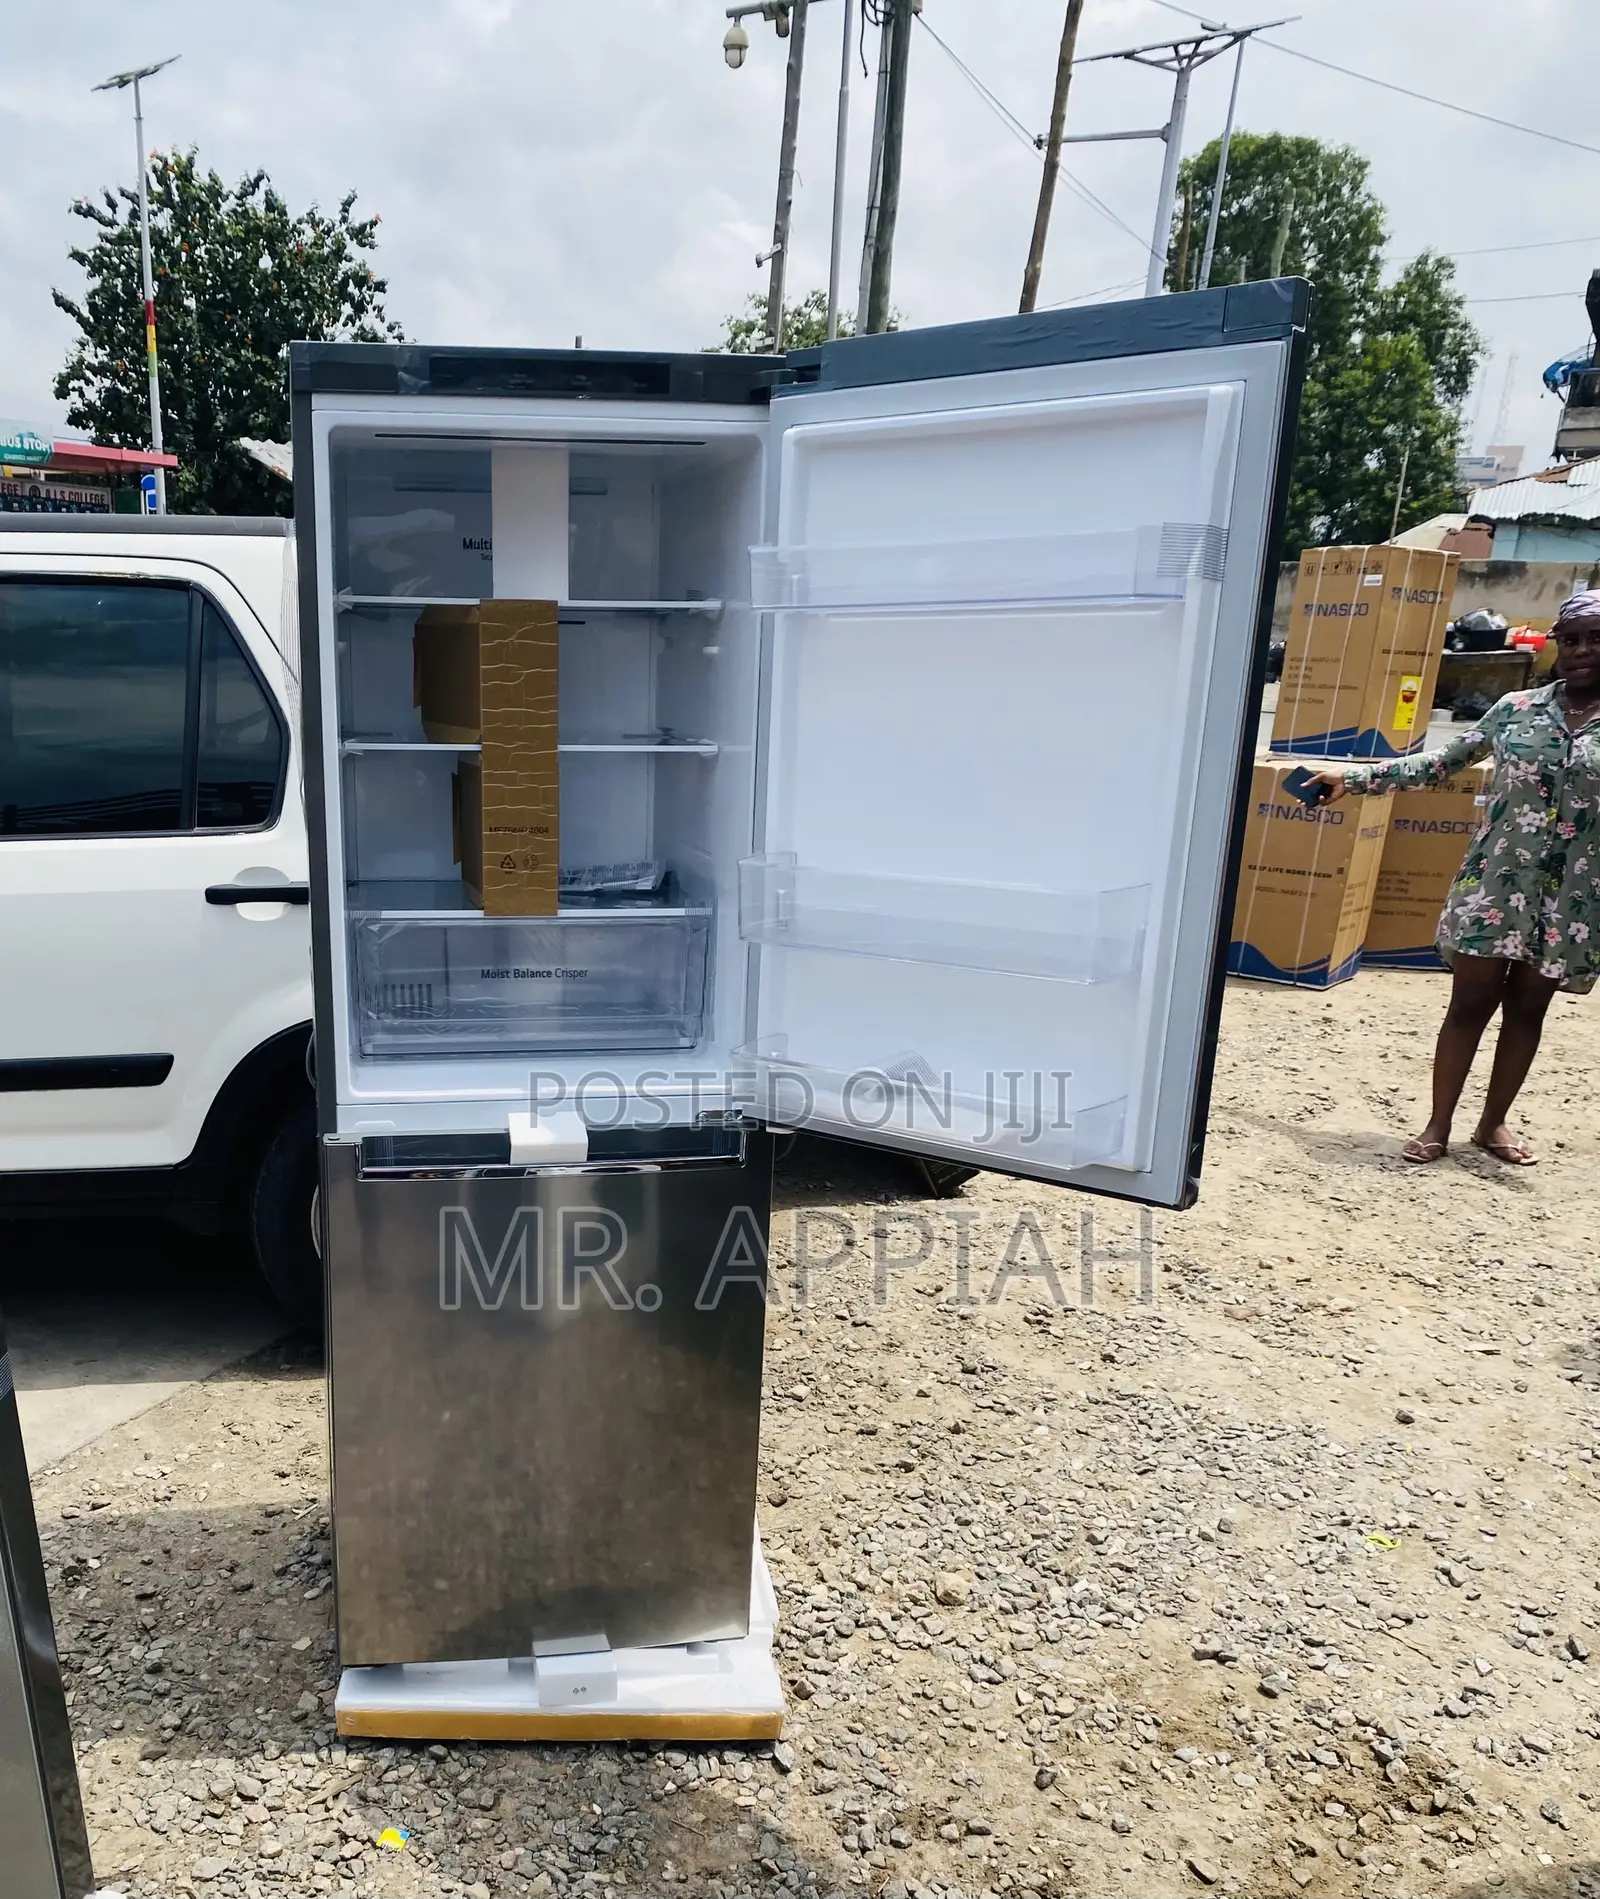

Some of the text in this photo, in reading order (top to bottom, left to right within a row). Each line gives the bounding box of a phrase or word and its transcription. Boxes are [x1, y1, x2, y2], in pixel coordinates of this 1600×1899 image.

[0, 435, 21, 449] BUS
[69, 490, 105, 504] COLLEGE
[1404, 588, 1443, 605] NASCO
[1316, 602, 1369, 617] NASCO
[1276, 805, 1345, 825] NASCO
[1411, 819, 1482, 835] NASCO
[1268, 866, 1284, 874] LIFE
[1286, 868, 1306, 876] MORE
[481, 967, 588, 982] Moist Balance Crisper
